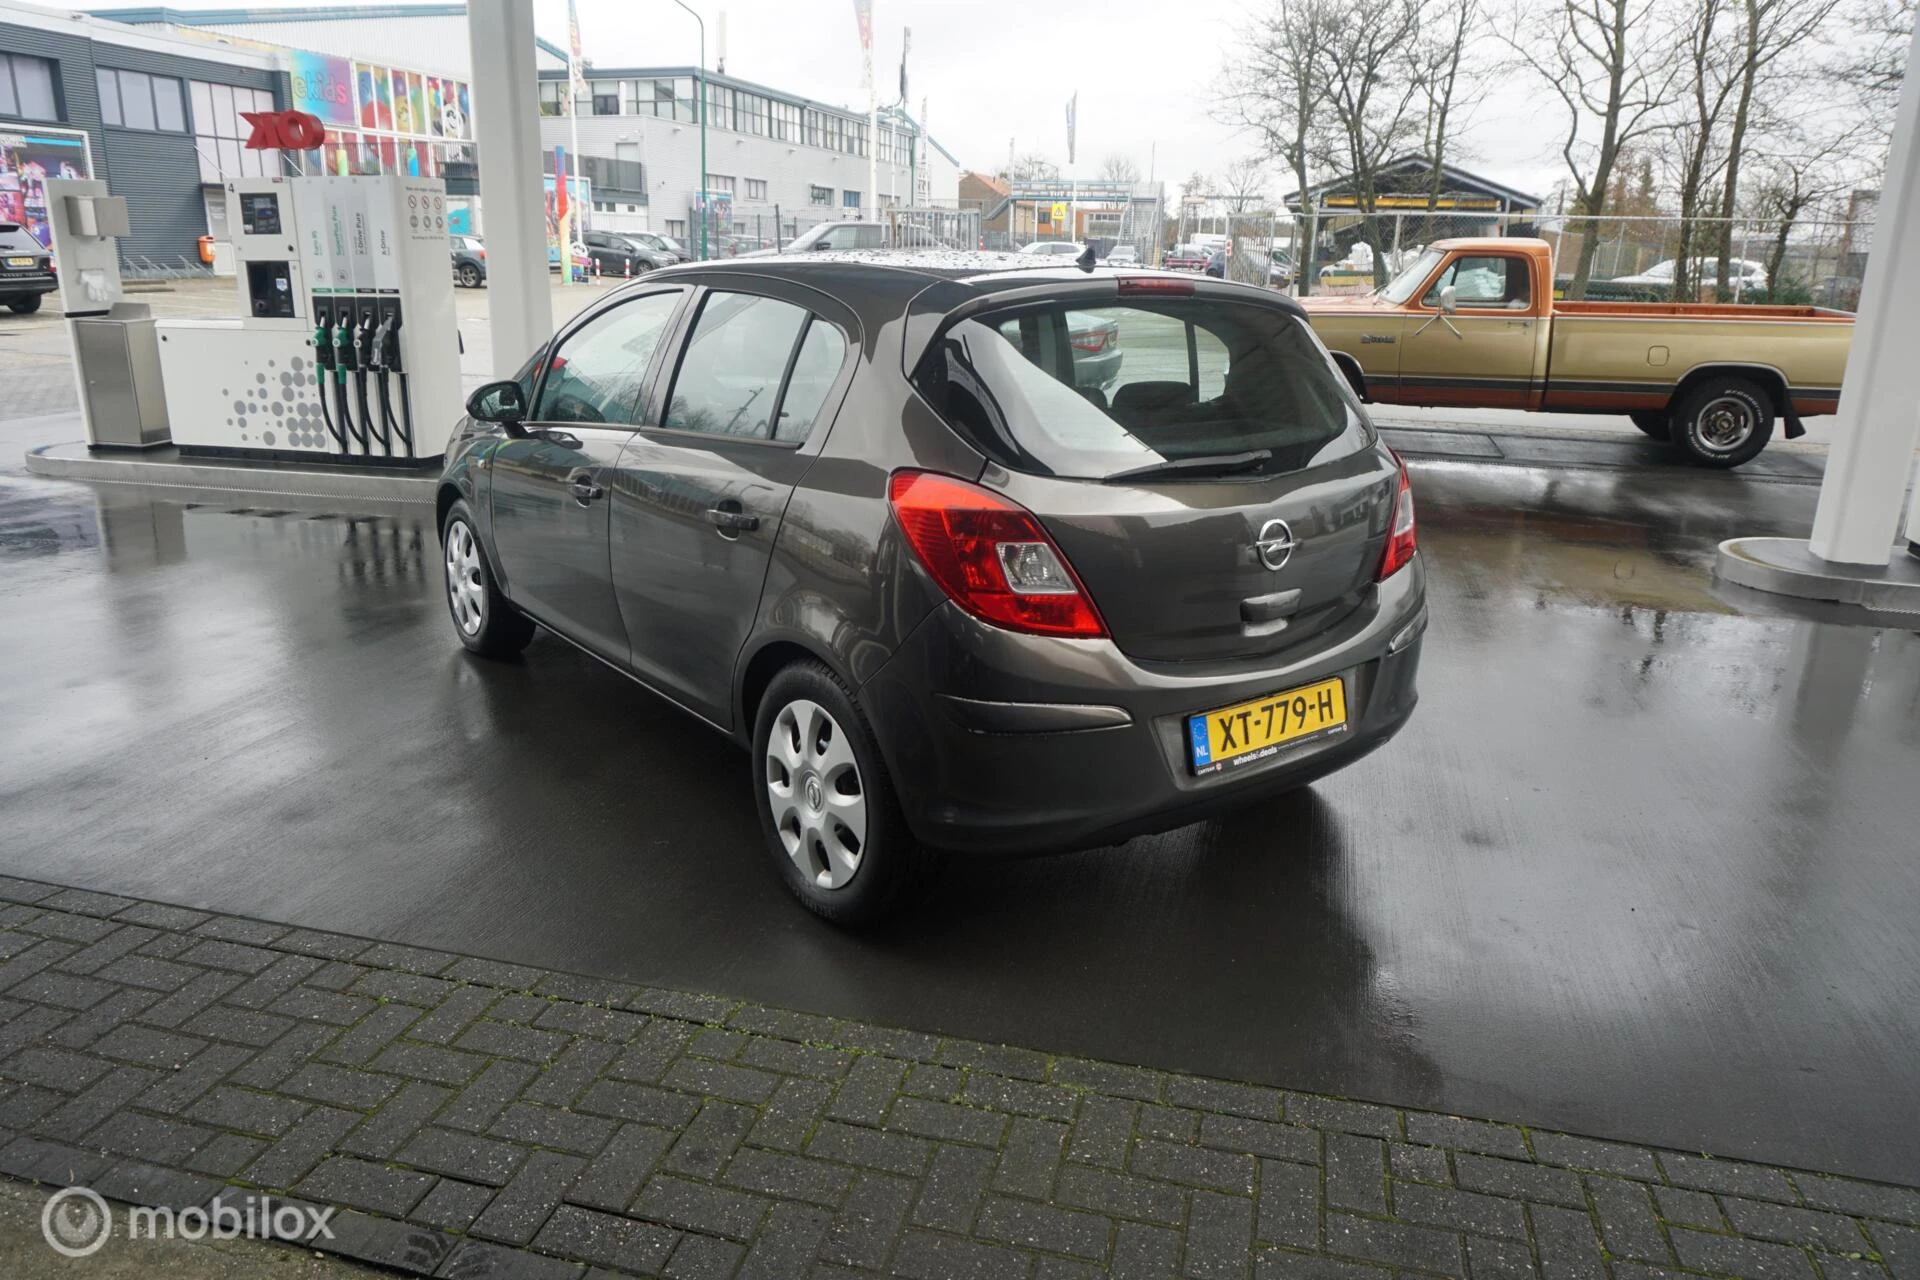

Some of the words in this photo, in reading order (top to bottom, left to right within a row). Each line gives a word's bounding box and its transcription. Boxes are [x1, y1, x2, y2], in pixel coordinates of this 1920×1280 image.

[228, 183, 235, 193] 4
[1218, 688, 1334, 752] XT-779-H
[1196, 746, 1209, 758] NL
